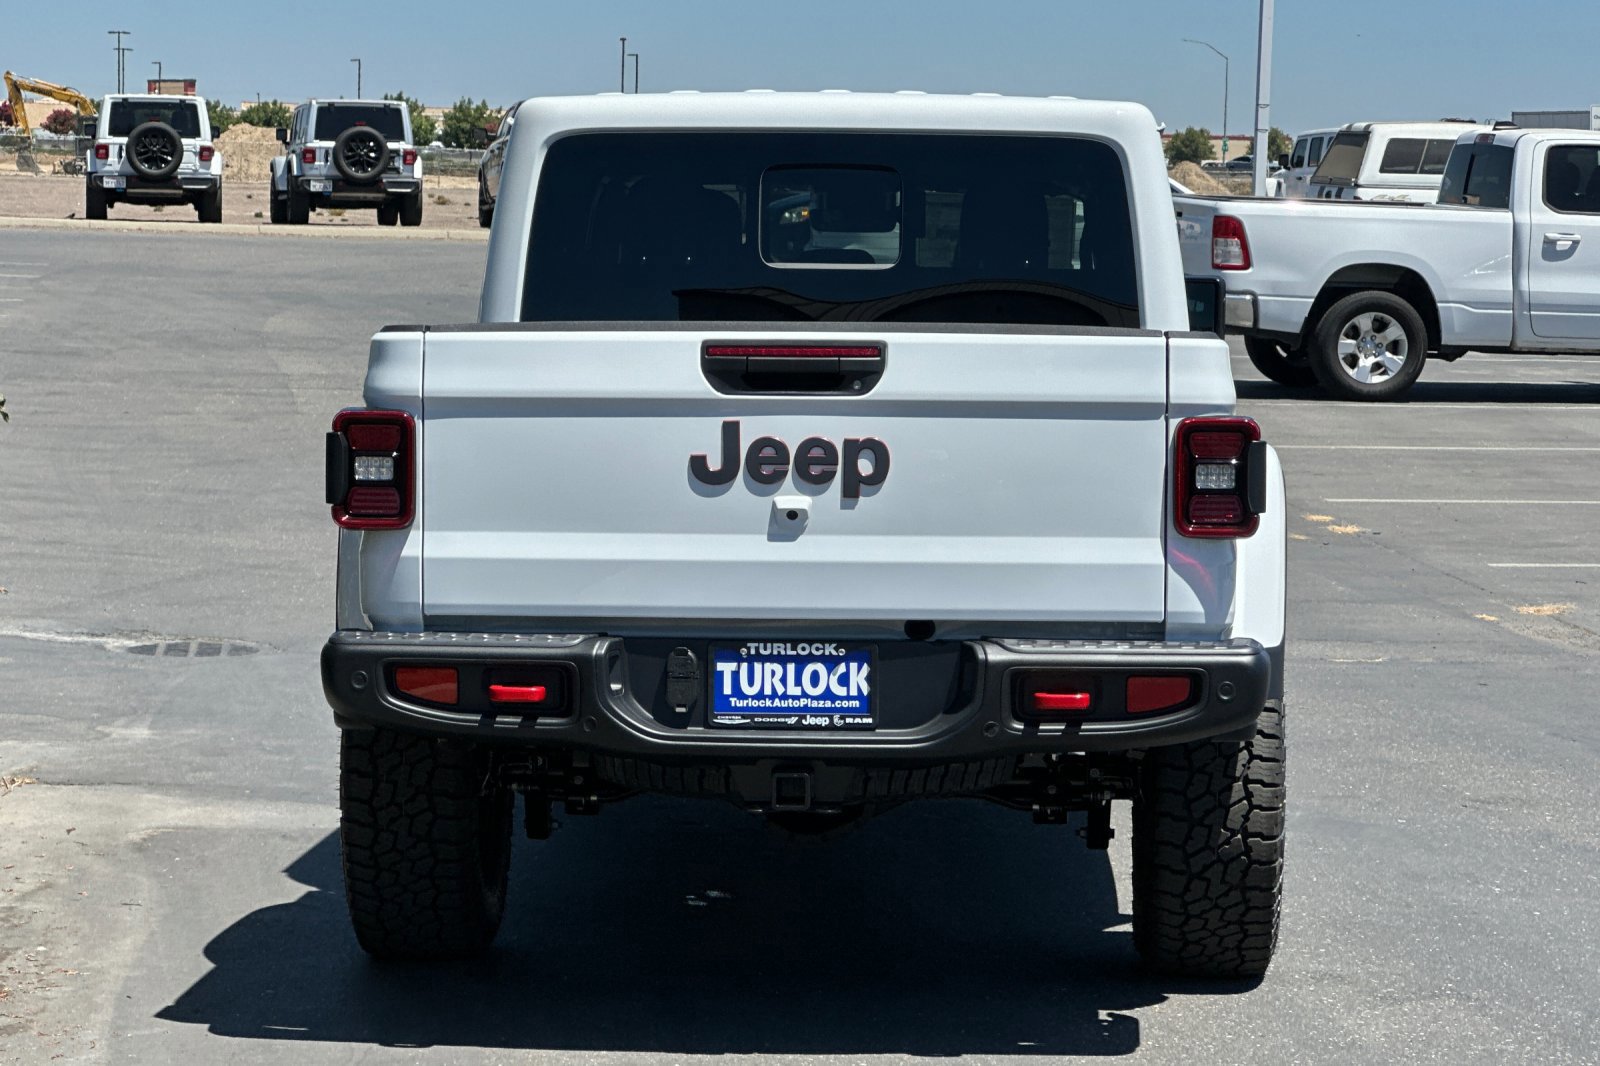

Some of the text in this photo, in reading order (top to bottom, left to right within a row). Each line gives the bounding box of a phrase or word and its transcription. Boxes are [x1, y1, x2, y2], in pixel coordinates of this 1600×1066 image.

[690, 420, 891, 499] Jeep
[747, 643, 838, 656] TURLOCK
[716, 662, 871, 697] TURLOCK
[729, 698, 860, 708] TurlockAutoPlaza.com
[802, 715, 830, 727] Jeep
